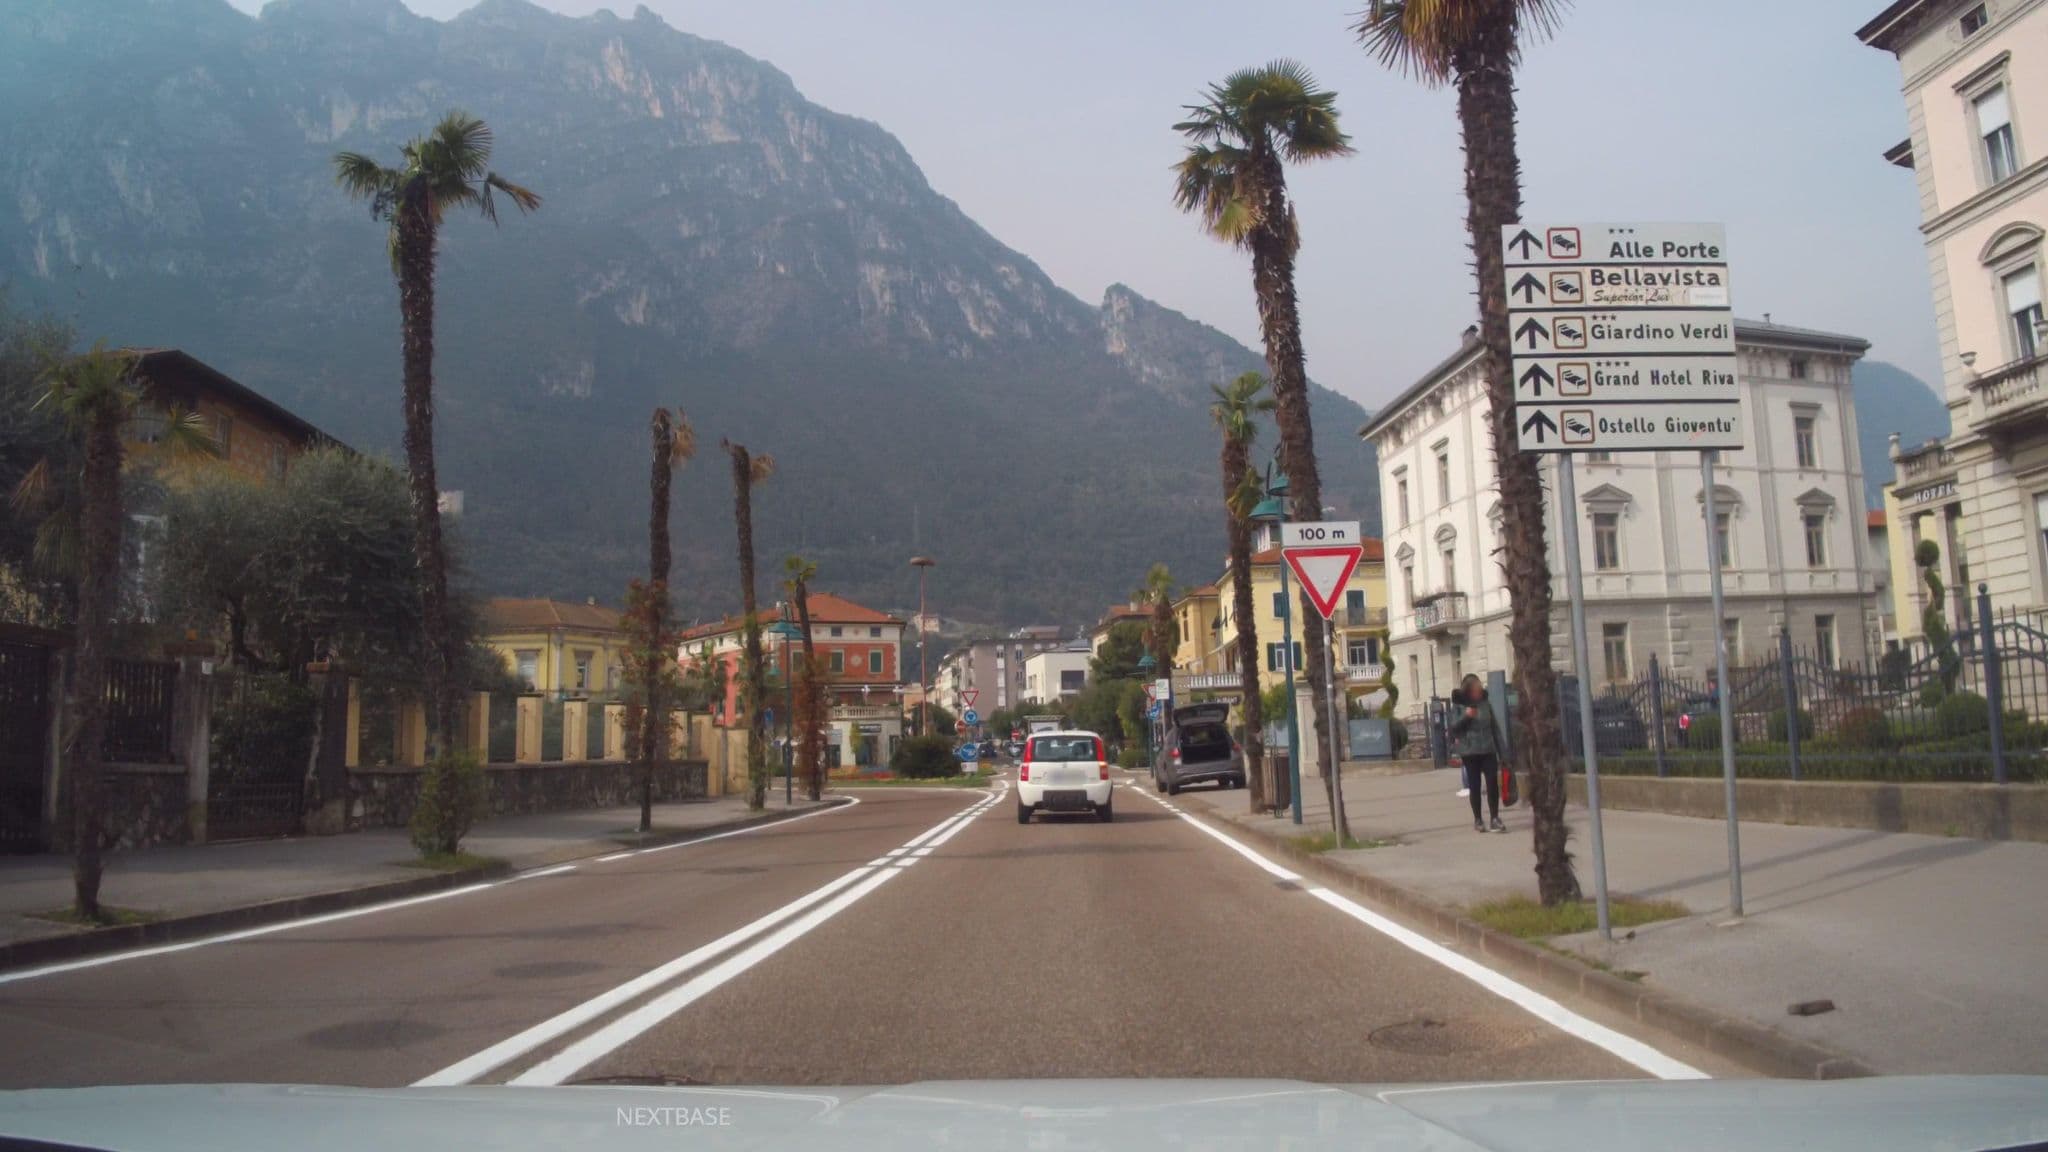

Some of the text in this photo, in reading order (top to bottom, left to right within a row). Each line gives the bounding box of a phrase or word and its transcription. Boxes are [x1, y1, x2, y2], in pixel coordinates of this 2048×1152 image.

[1609, 241, 1720, 258] Alle Porte
[1591, 268, 1721, 286] Bellavista
[1591, 324, 1728, 340] Giardino Verdi
[1594, 369, 1735, 386] Grand Hotel Riva
[1598, 417, 1656, 434] Ostello
[1299, 528, 1344, 540] 100 m
